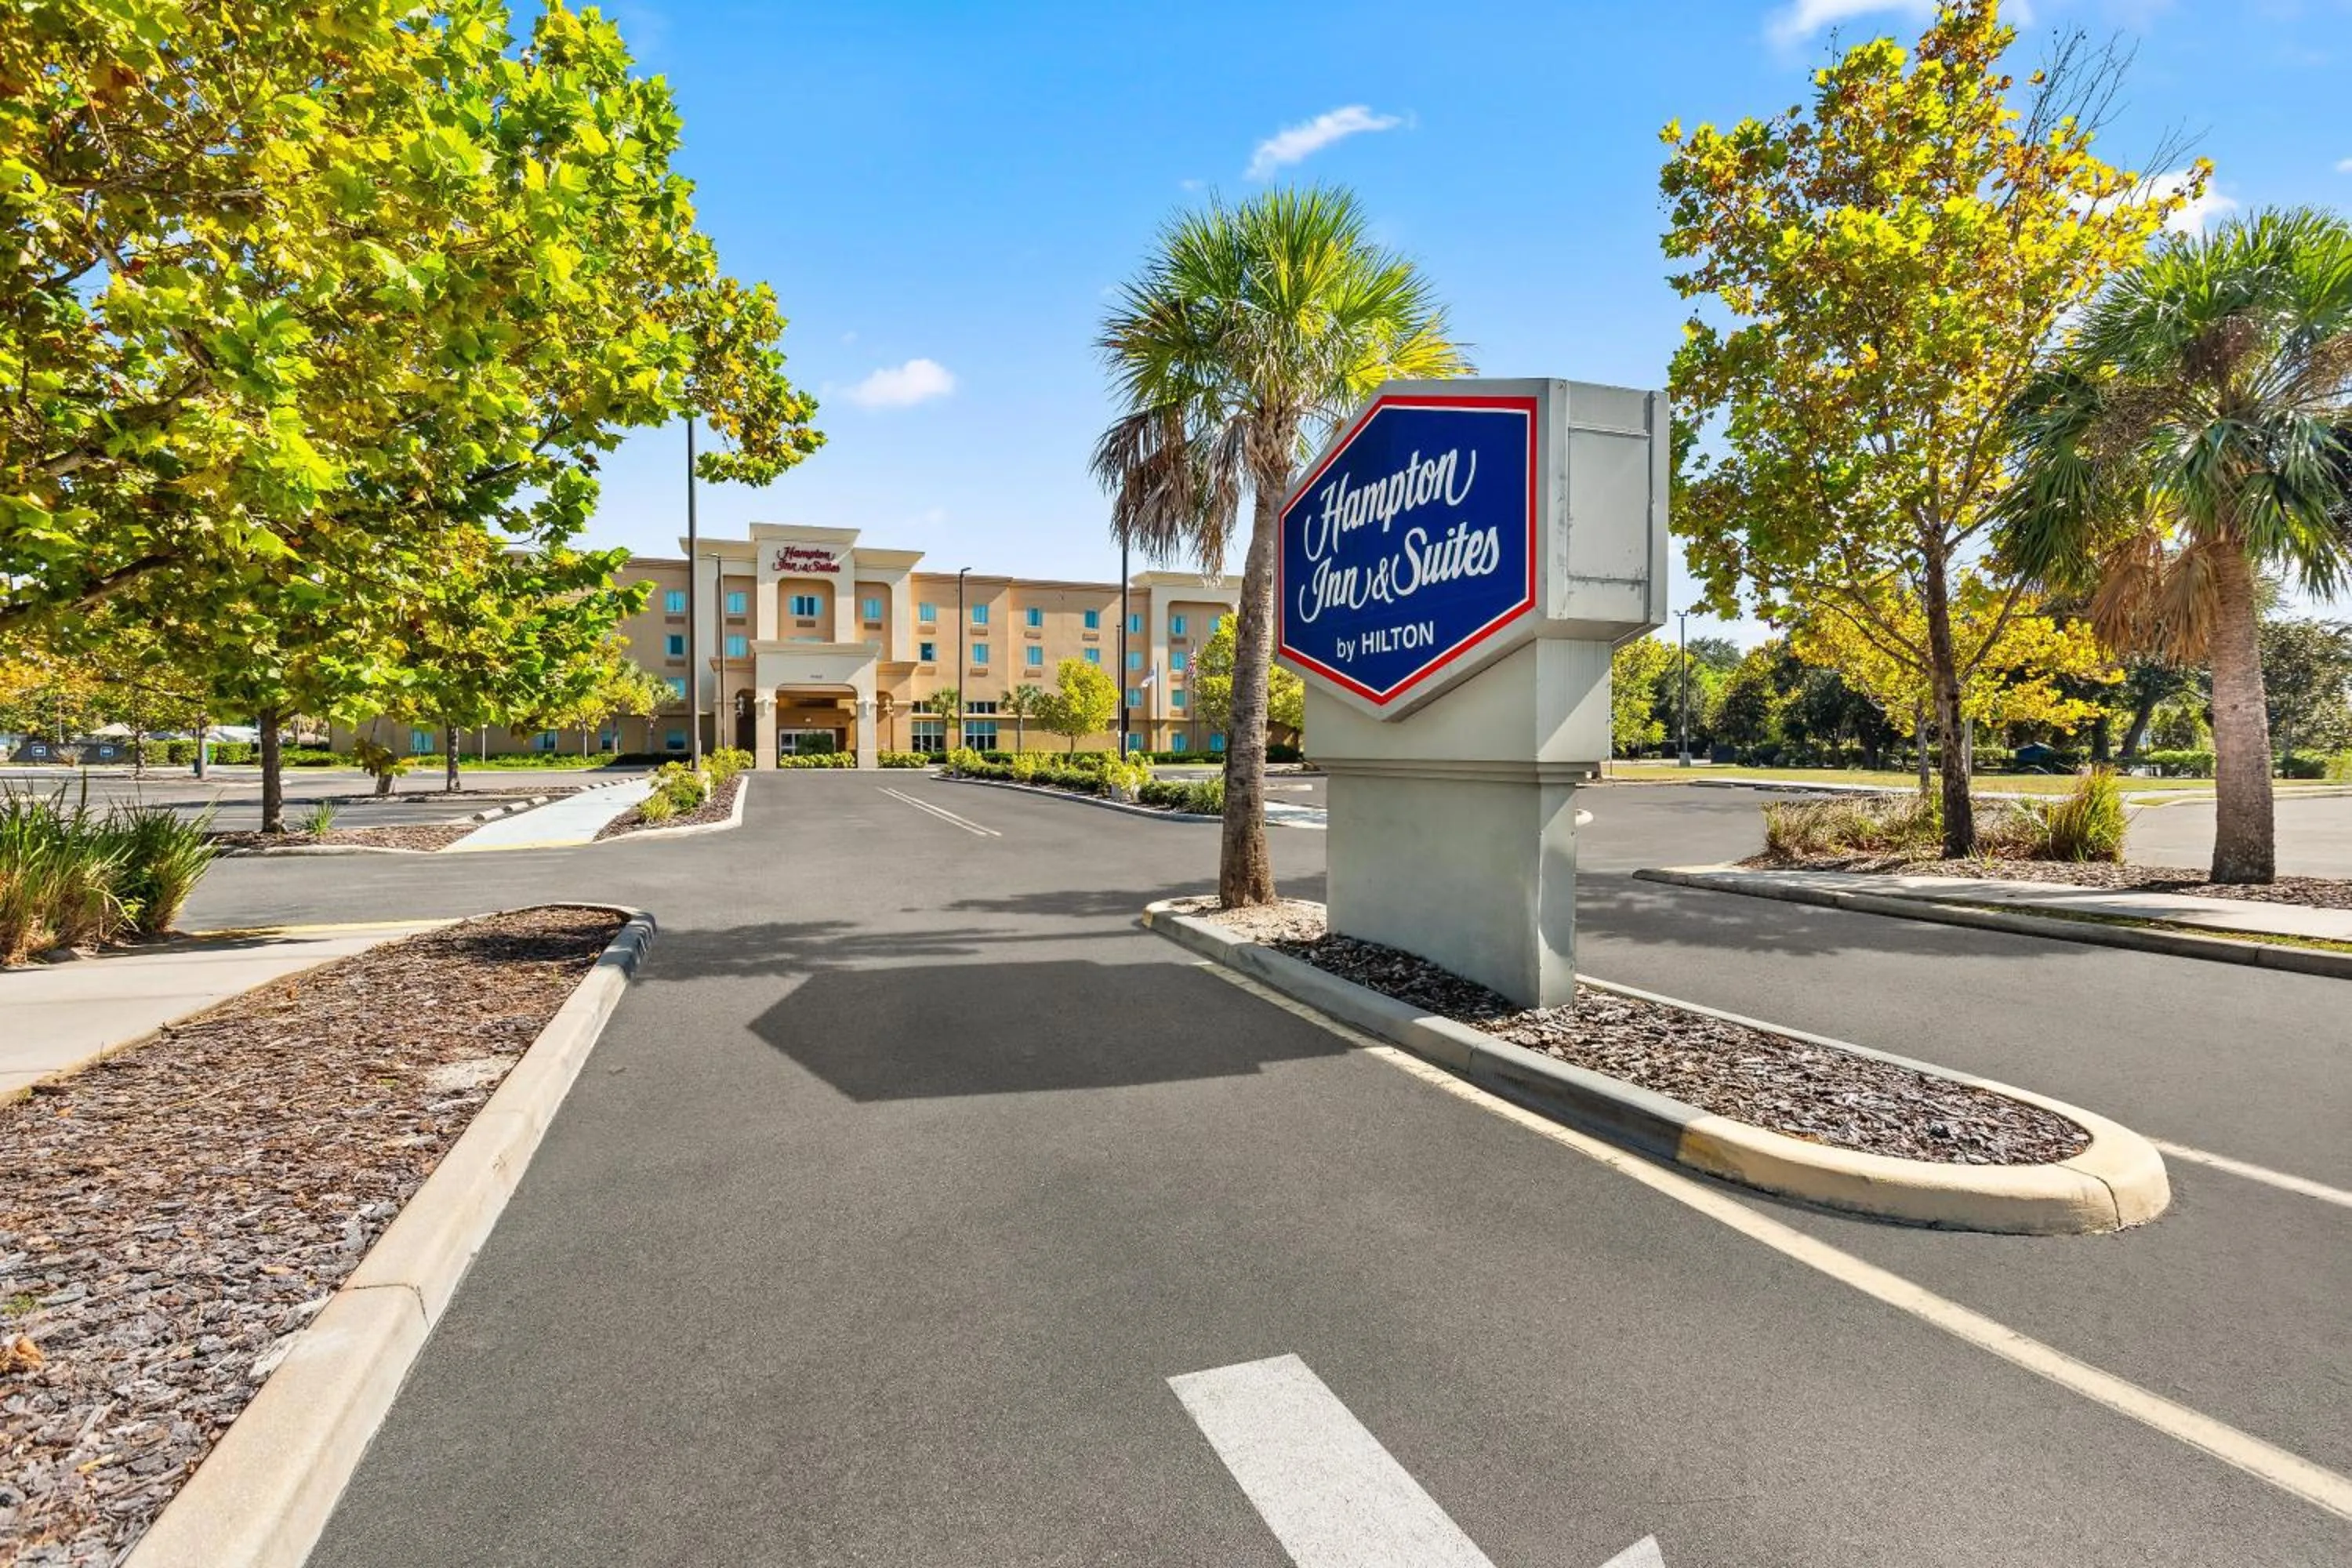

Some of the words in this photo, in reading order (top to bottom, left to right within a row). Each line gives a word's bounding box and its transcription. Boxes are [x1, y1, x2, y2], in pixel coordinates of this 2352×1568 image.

[1305, 449, 1476, 562] Hampton
[776, 546, 836, 561] Hampton
[1299, 557, 1372, 623] Inn
[1372, 557, 1394, 604] &
[1391, 521, 1501, 597] Suites
[1337, 637, 1356, 662] by
[1362, 620, 1435, 655] HILTON
